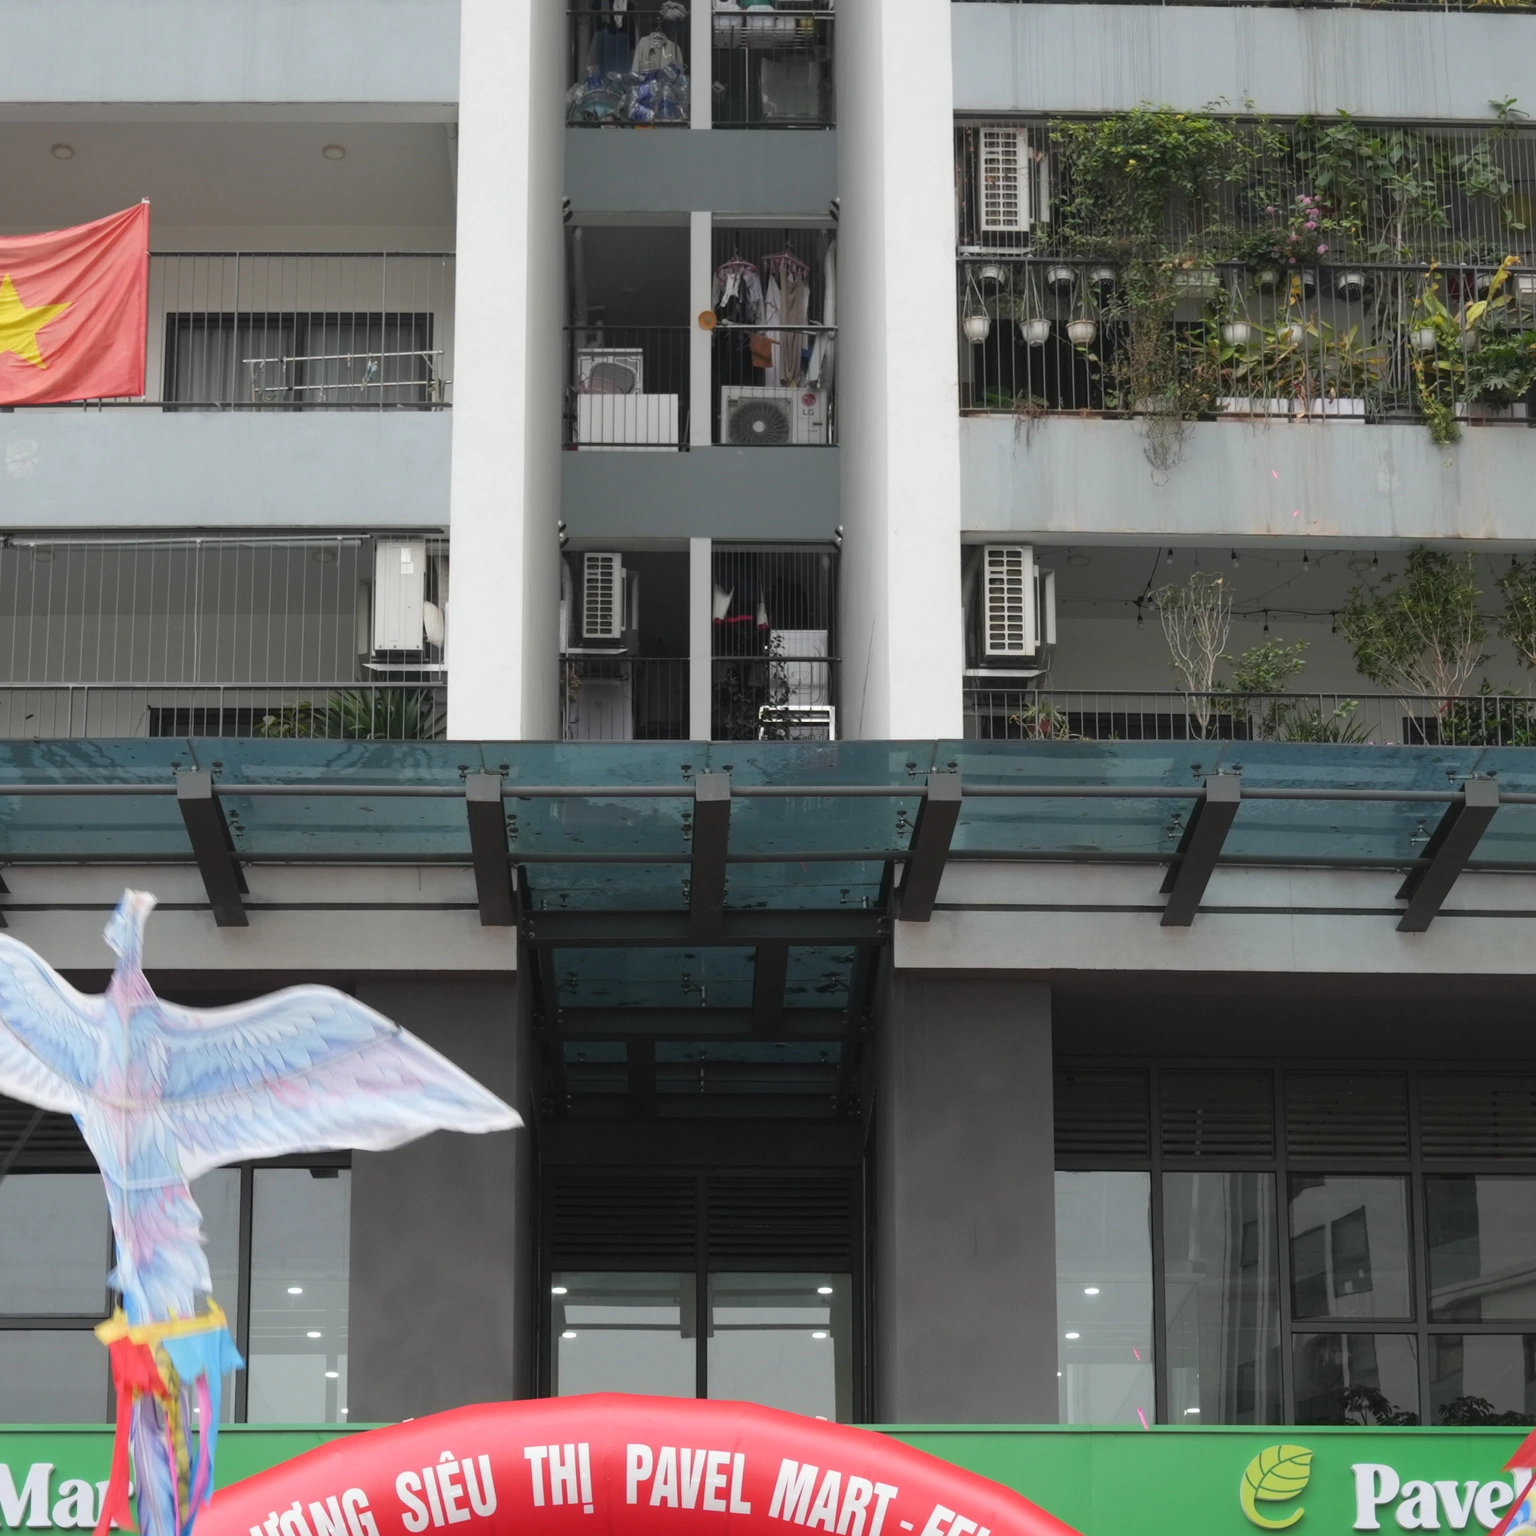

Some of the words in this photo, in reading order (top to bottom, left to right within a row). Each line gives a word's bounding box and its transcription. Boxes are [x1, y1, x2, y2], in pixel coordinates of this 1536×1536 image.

[802, 408, 815, 417] LG
[394, 1450, 498, 1533] SIÊU
[523, 1442, 594, 1514] THỊ
[626, 1443, 751, 1514] PAVEL
